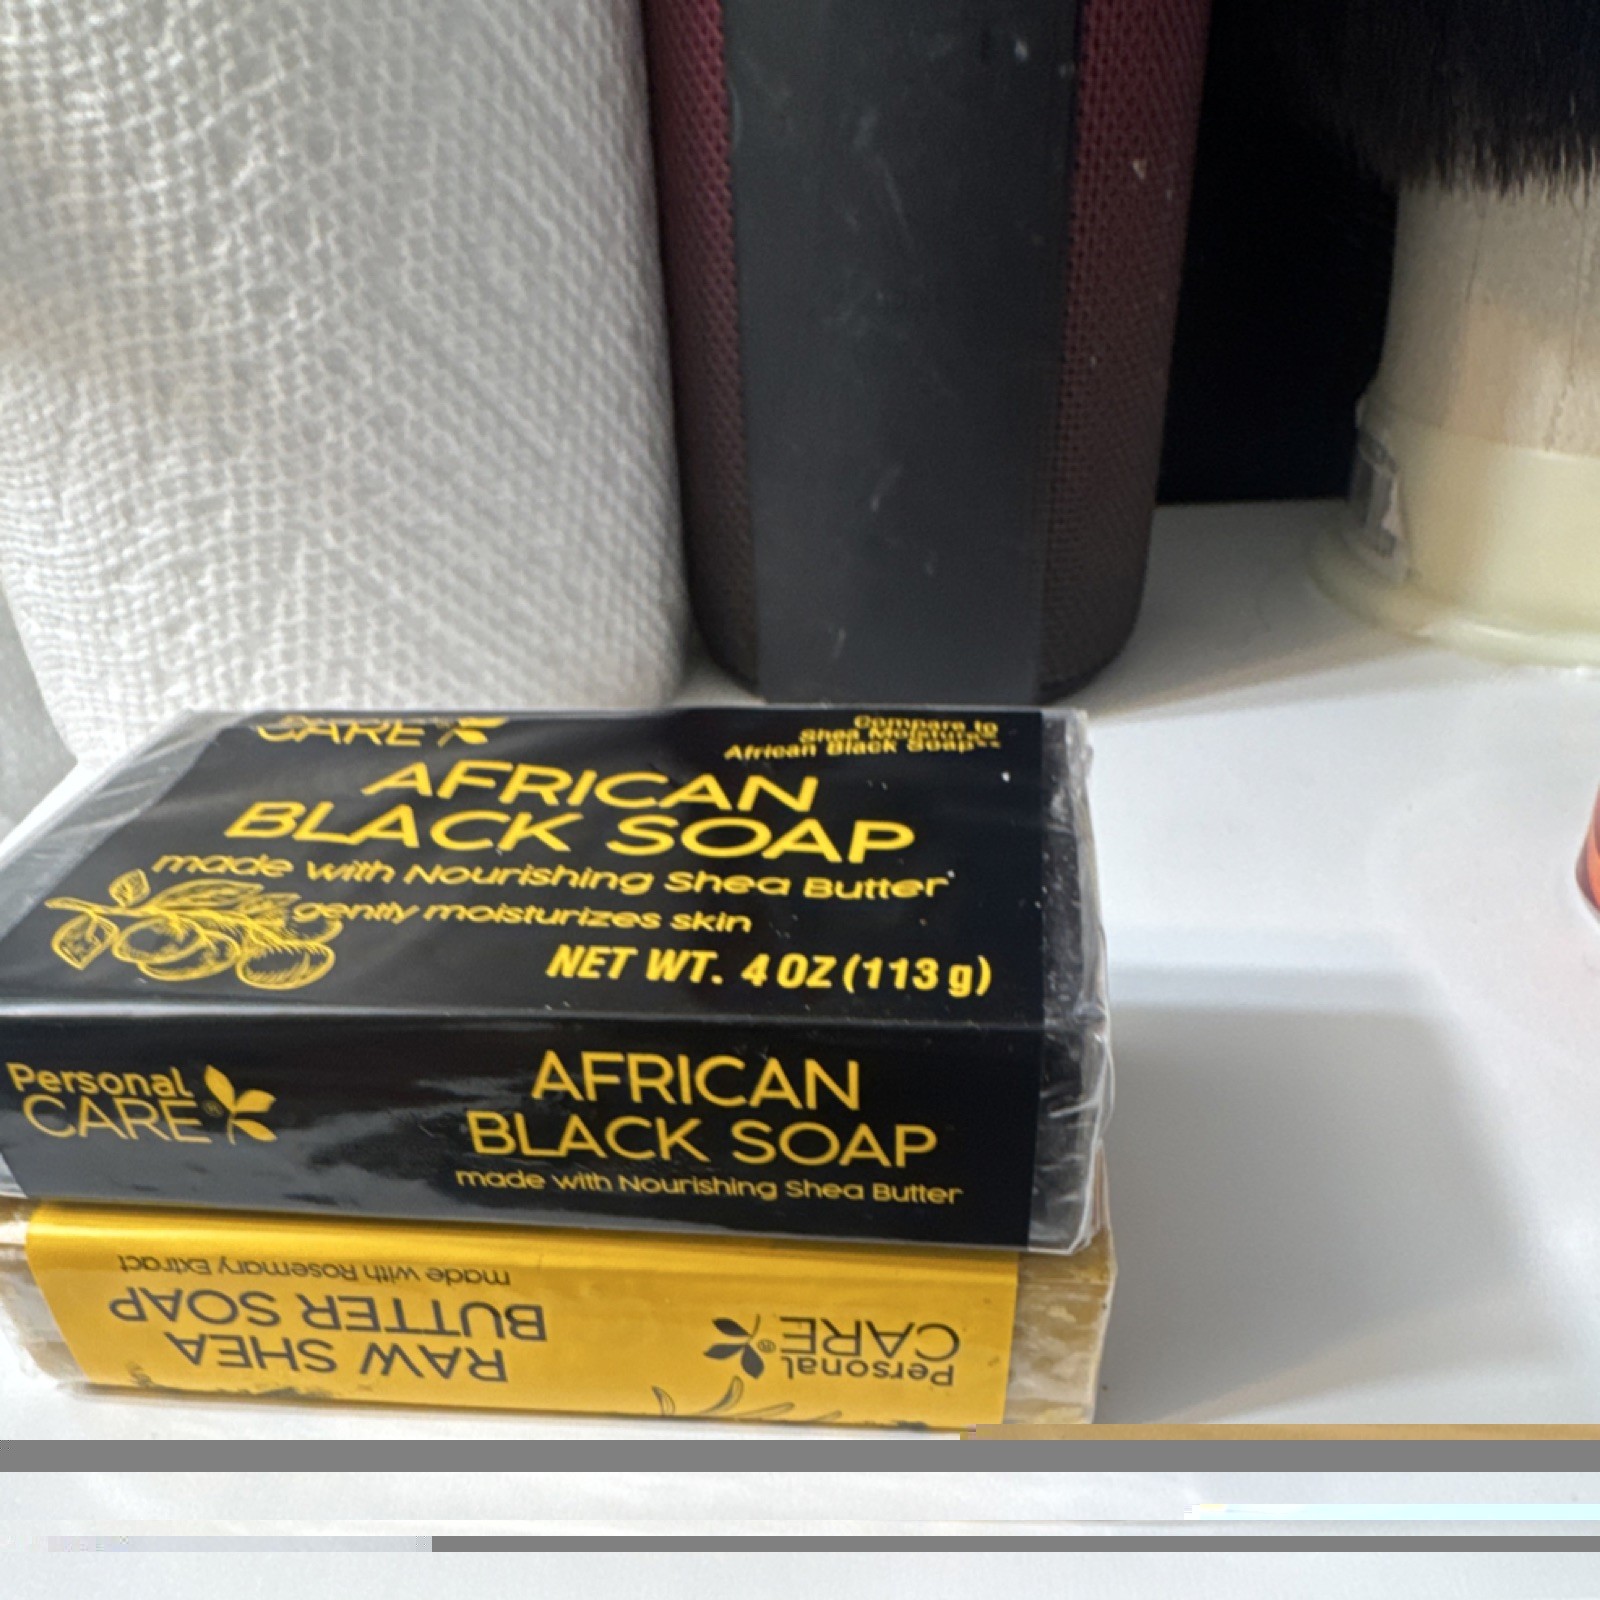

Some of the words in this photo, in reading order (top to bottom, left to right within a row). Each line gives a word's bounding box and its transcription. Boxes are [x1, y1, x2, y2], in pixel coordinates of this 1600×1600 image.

[724, 743, 817, 760] African
[826, 739, 898, 757] Black
[362, 760, 819, 814] AFRICAN
[225, 801, 584, 852] BLACK
[607, 814, 915, 864] SOAP
[152, 854, 294, 878] made
[306, 859, 396, 884] with
[403, 863, 655, 896] Nourishing
[664, 870, 789, 896] Shea
[804, 877, 948, 900] Butter
[293, 900, 420, 925] gently
[423, 903, 662, 930] moisturizes
[670, 911, 752, 933] skin
[546, 944, 639, 980] NET
[645, 949, 724, 985] WT.
[740, 953, 769, 987] 4
[777, 953, 838, 989] OZ
[843, 953, 940, 994] (113
[947, 955, 992, 998] g)
[5, 1061, 195, 1098] Personal
[531, 1049, 860, 1111] AFRICAN
[466, 1110, 709, 1162] BLACK
[731, 1119, 938, 1168] SOAP
[455, 1169, 545, 1190] made
[553, 1173, 613, 1193] with
[620, 1175, 778, 1201] Nourishing
[785, 1180, 865, 1201] Shea
[873, 1182, 964, 1206] Butter
[118, 1253, 209, 1274] Extract
[218, 1256, 358, 1282] Rosemary
[362, 1264, 420, 1285] with
[425, 1267, 511, 1286] made
[109, 1287, 281, 1327] SOAP
[297, 1294, 548, 1342] BUTTER
[164, 1331, 338, 1374] SHEA
[359, 1341, 509, 1383] RAW
[780, 1355, 955, 1387] Personal
